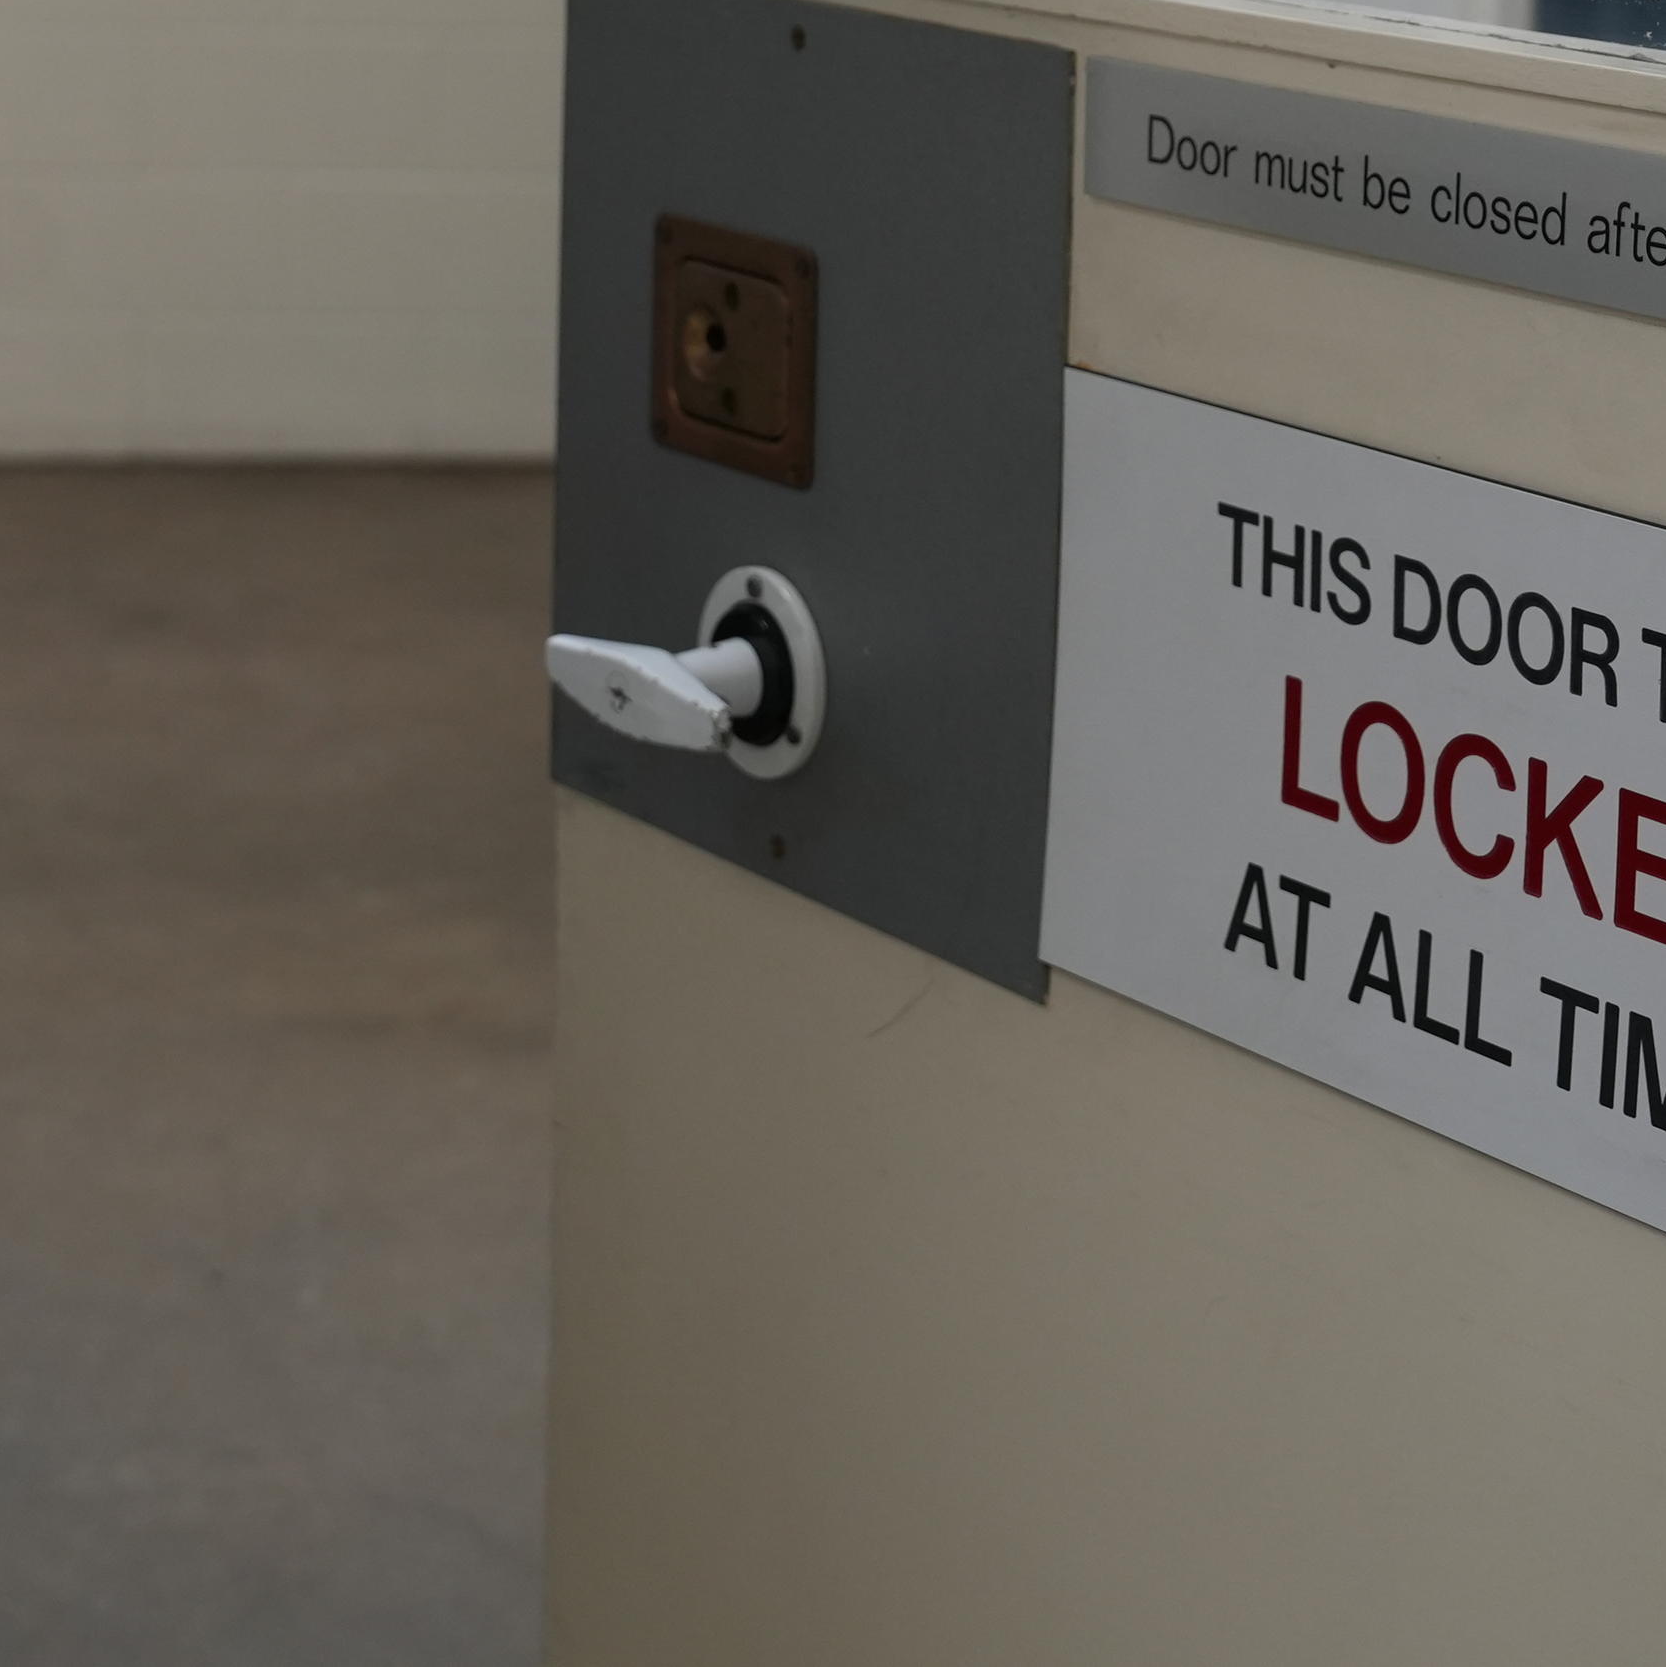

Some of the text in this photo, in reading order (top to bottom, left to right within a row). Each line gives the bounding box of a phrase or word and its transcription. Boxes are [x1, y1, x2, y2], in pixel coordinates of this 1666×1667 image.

[1146, 114, 1239, 179] Door
[1253, 150, 1345, 203] must
[1361, 154, 1412, 215] be
[1430, 171, 1567, 246] closed
[1217, 501, 1372, 626] THIS
[1392, 553, 1620, 708] DOOR
[1223, 861, 1332, 982] AT
[1347, 911, 1513, 1068] ALL
